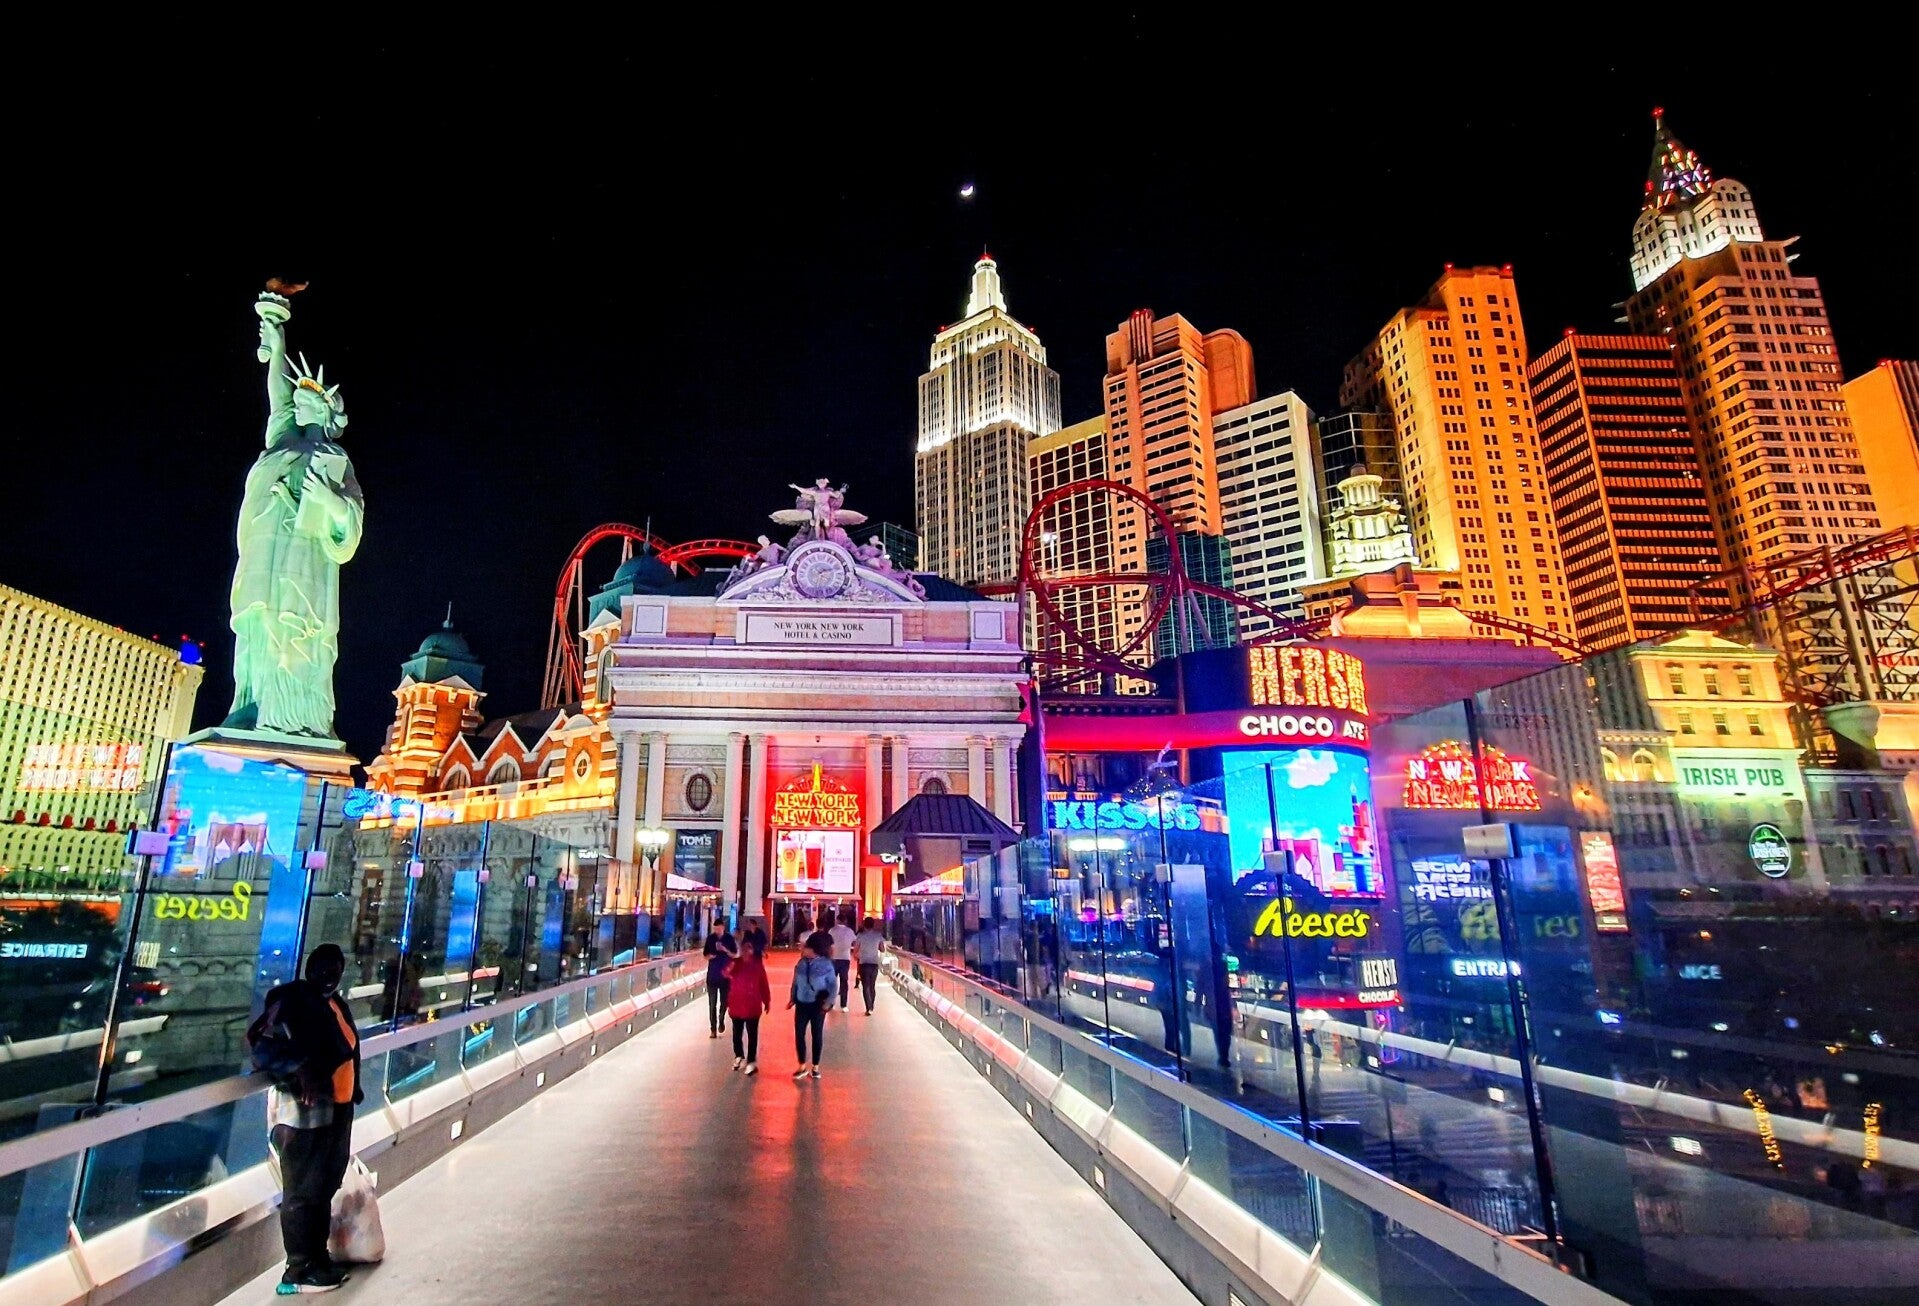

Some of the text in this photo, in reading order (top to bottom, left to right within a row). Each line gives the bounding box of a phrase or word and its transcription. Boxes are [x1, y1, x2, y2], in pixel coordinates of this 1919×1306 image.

[774, 622, 864, 631] NEW YORK NEW YORK
[784, 631, 810, 639] HOTEL
[821, 632, 852, 640] CASINO
[1682, 767, 1785, 786] IRISH PUB
[776, 792, 858, 808] NEW YORK
[776, 808, 859, 824] NEW YORK
[680, 834, 712, 846] TOM'S
[1254, 896, 1371, 937] Reese's
